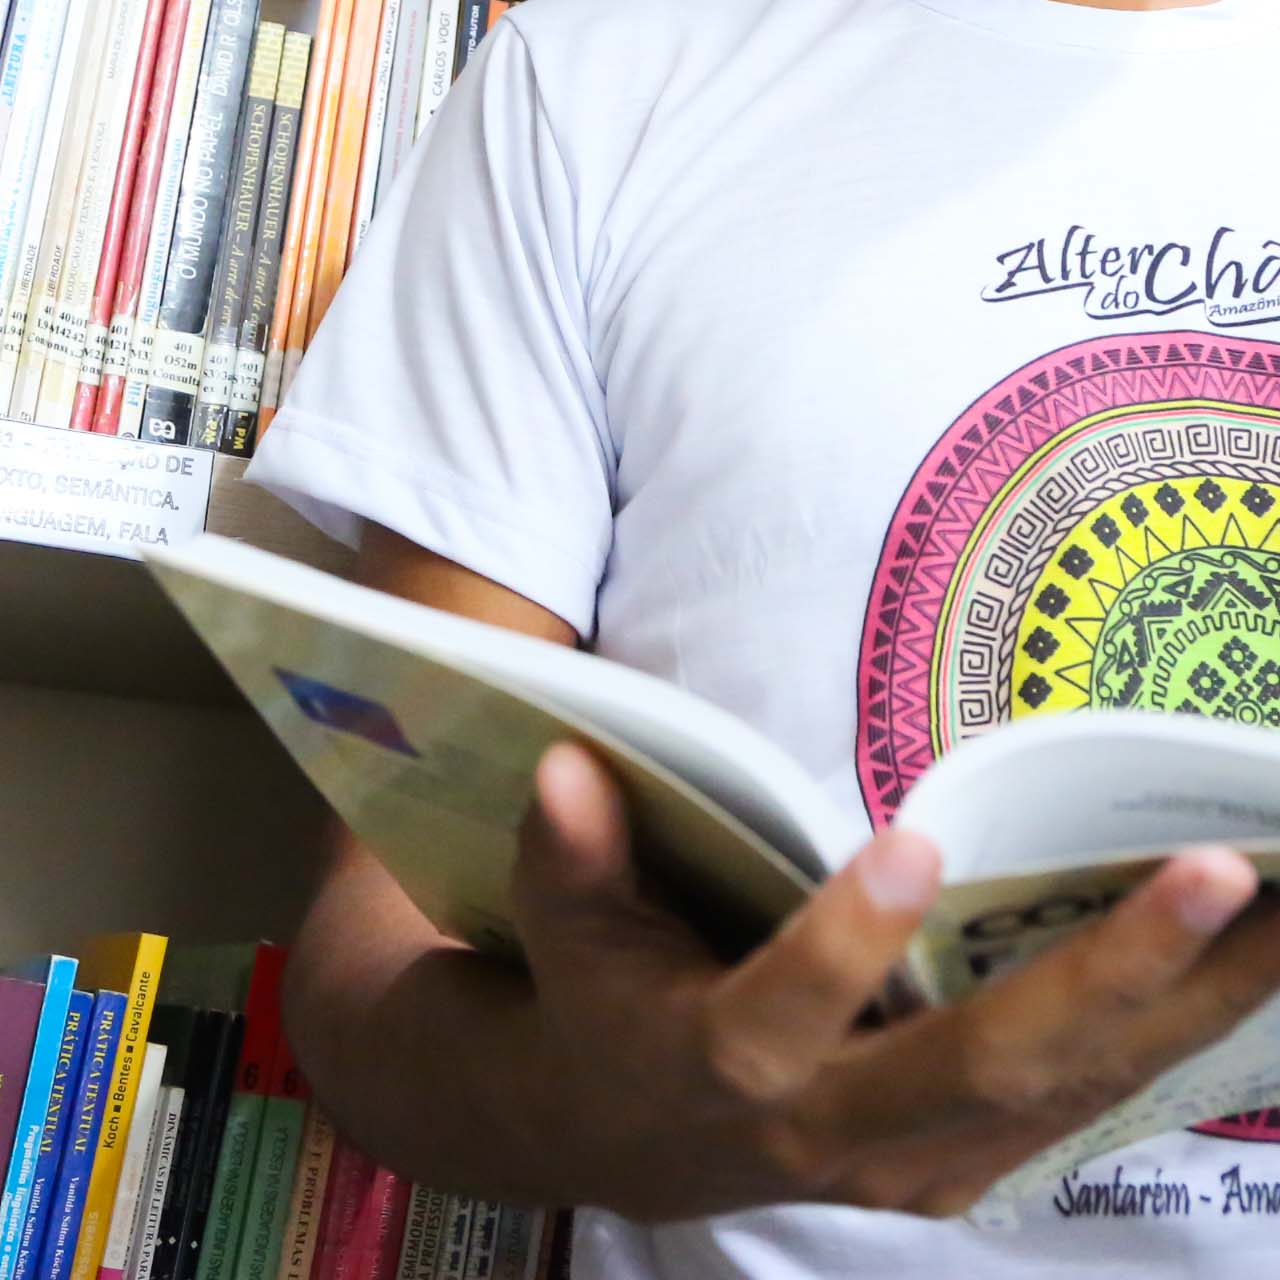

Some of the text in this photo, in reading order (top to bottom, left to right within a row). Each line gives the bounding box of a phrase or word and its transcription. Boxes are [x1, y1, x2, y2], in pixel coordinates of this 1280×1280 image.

[432, 11, 452, 96] CARLOS VOGT
[186, 196, 208, 263] MUNDO
[197, 166, 212, 192] NO
[211, 53, 232, 97] DAVID
[232, 103, 265, 232] SCHOPENHAUER
[995, 225, 1154, 292] Alter
[1100, 276, 1140, 310] do
[165, 457, 194, 476] DE
[120, 523, 169, 546] FALA
[89, 1010, 114, 1079] PRÁTICA
[102, 1115, 119, 1149] Koch
[113, 1057, 132, 1103] Bentes
[125, 971, 151, 1041] Cavalcante
[73, 1081, 99, 1152] TEXTUAL
[63, 1176, 79, 1212] Vanilda
[1053, 1167, 1190, 1217] Santarém
[57, 1214, 70, 1245] Salton
